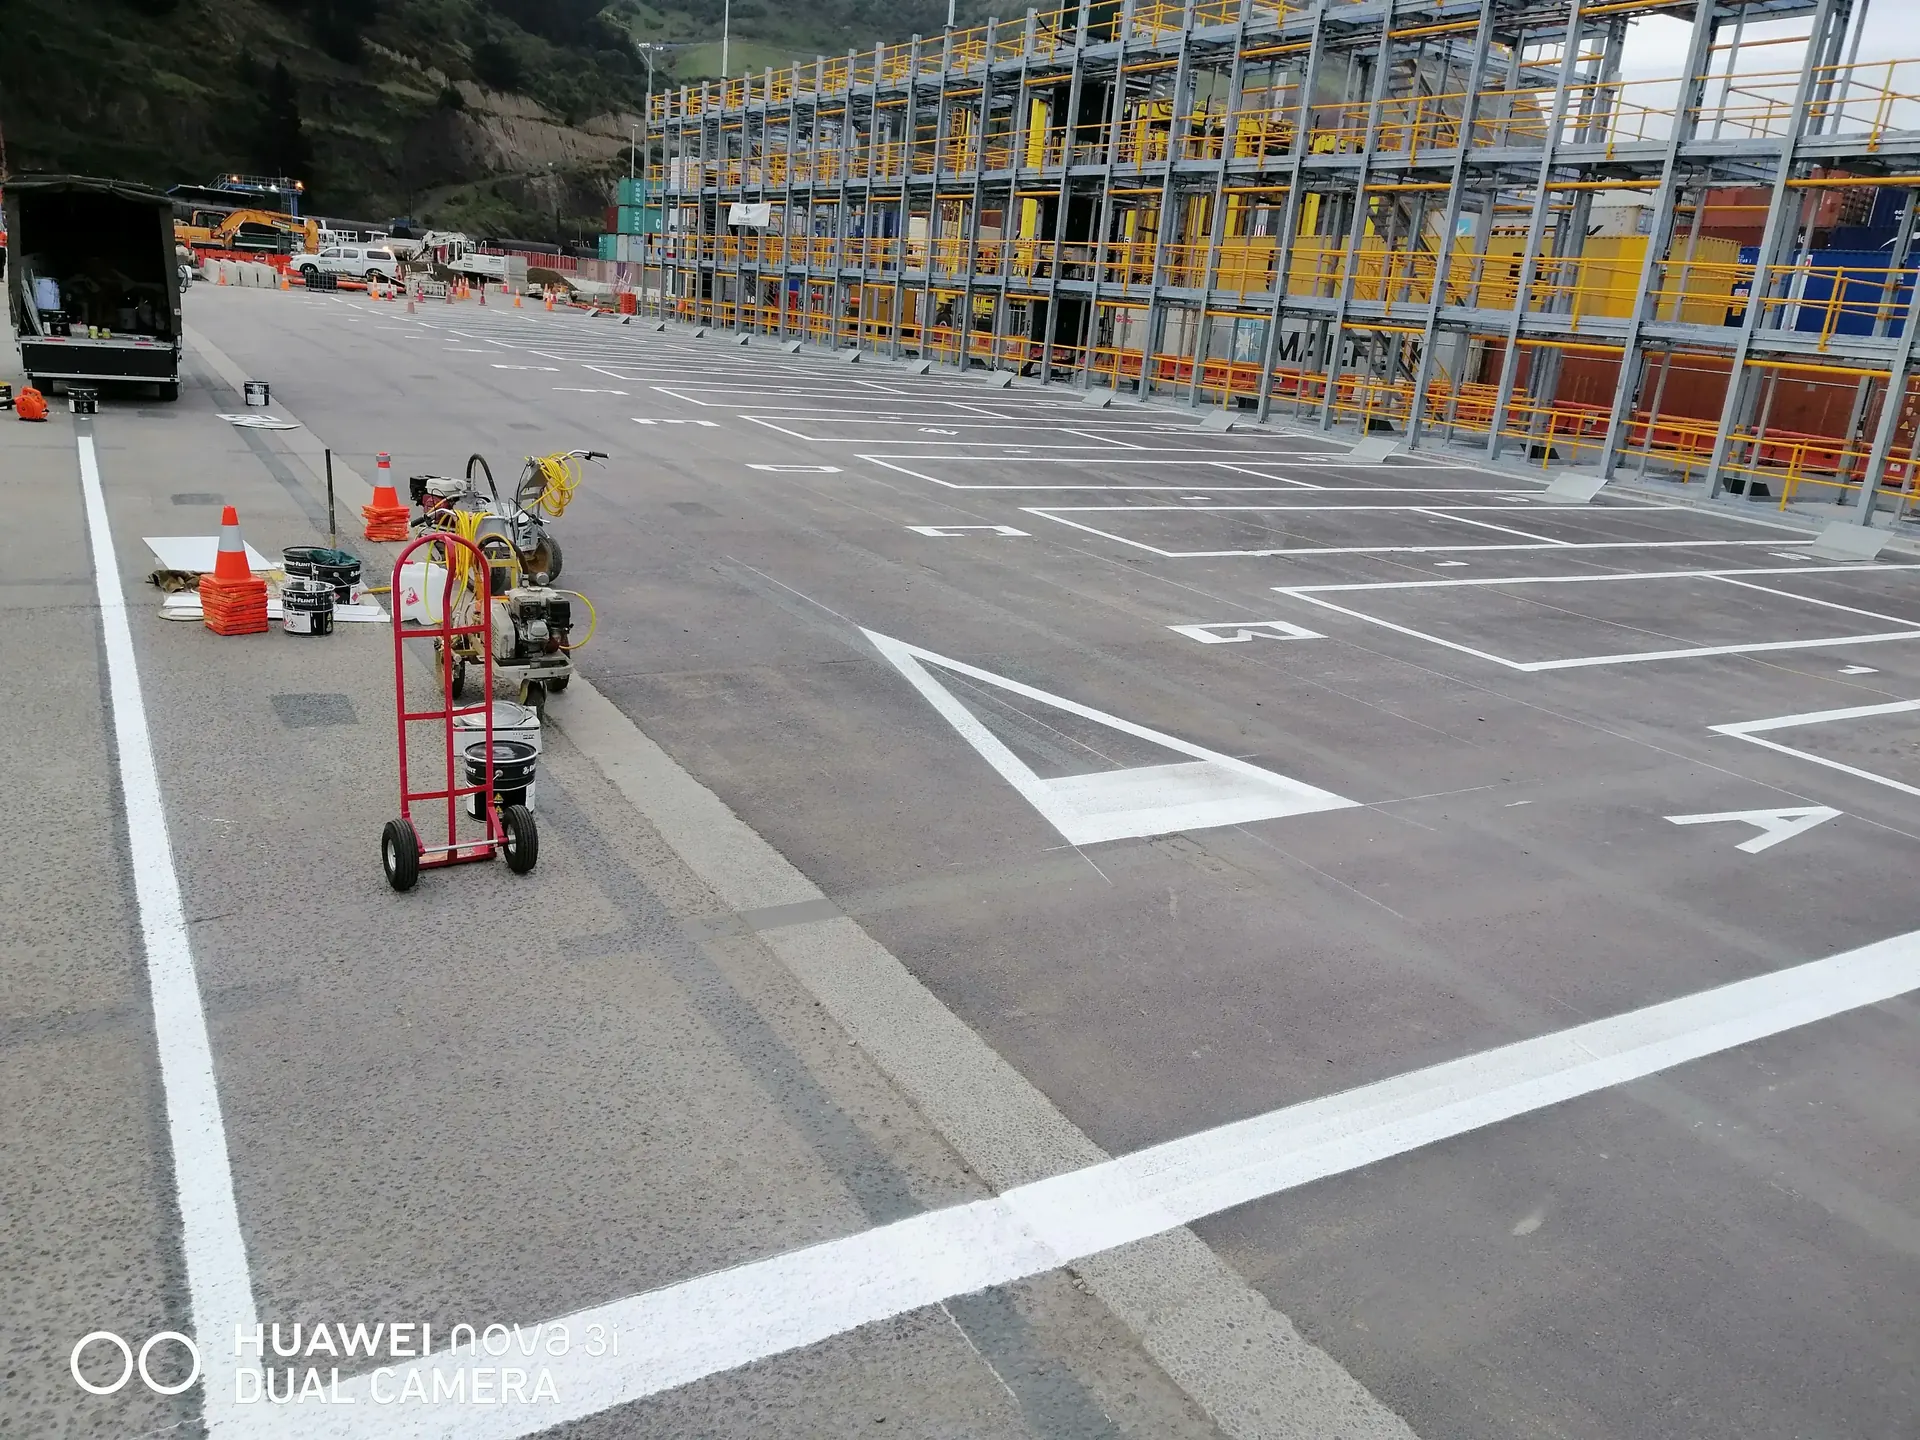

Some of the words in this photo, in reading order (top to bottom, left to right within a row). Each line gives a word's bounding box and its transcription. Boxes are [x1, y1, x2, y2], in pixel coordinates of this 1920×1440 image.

[745, 463, 844, 473] D
[906, 525, 1031, 537] C
[1664, 805, 1843, 854] A
